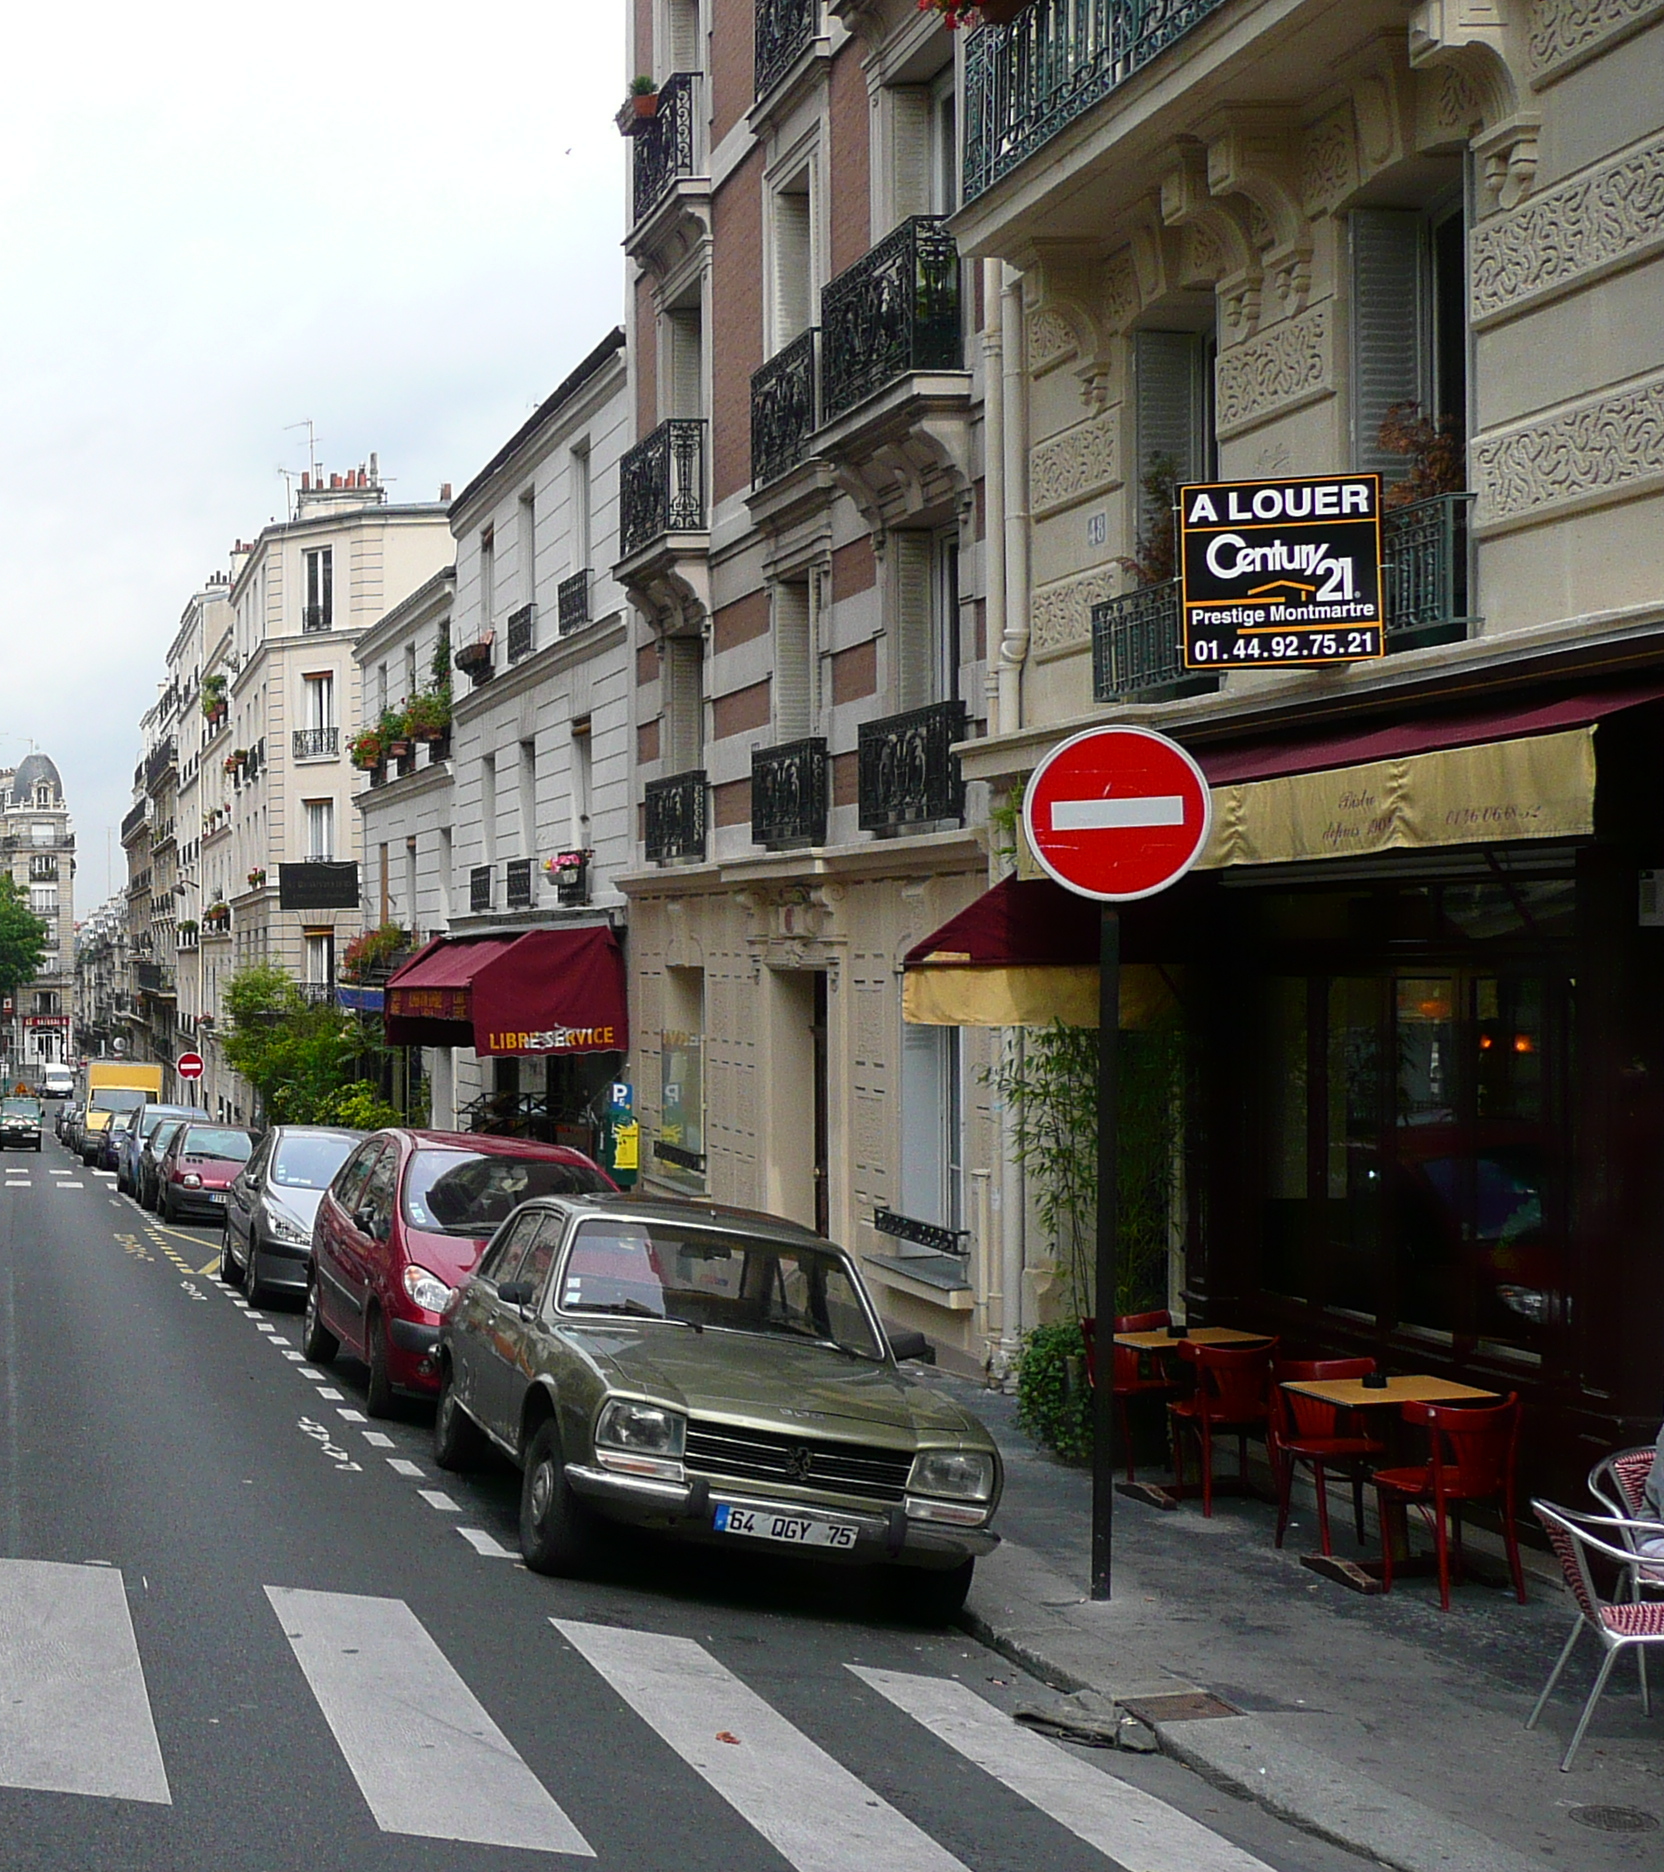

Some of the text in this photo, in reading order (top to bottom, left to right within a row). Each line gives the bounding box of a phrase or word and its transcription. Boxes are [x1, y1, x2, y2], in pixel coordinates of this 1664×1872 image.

[1188, 484, 1369, 523] A LOUER
[1088, 515, 1104, 545] 48
[1206, 533, 1354, 601] Century 21
[1191, 602, 1374, 626] Prestige Montmartre
[489, 1026, 614, 1050] LIBRE SERVICE
[729, 1510, 853, 1545] 64 QGY 75
